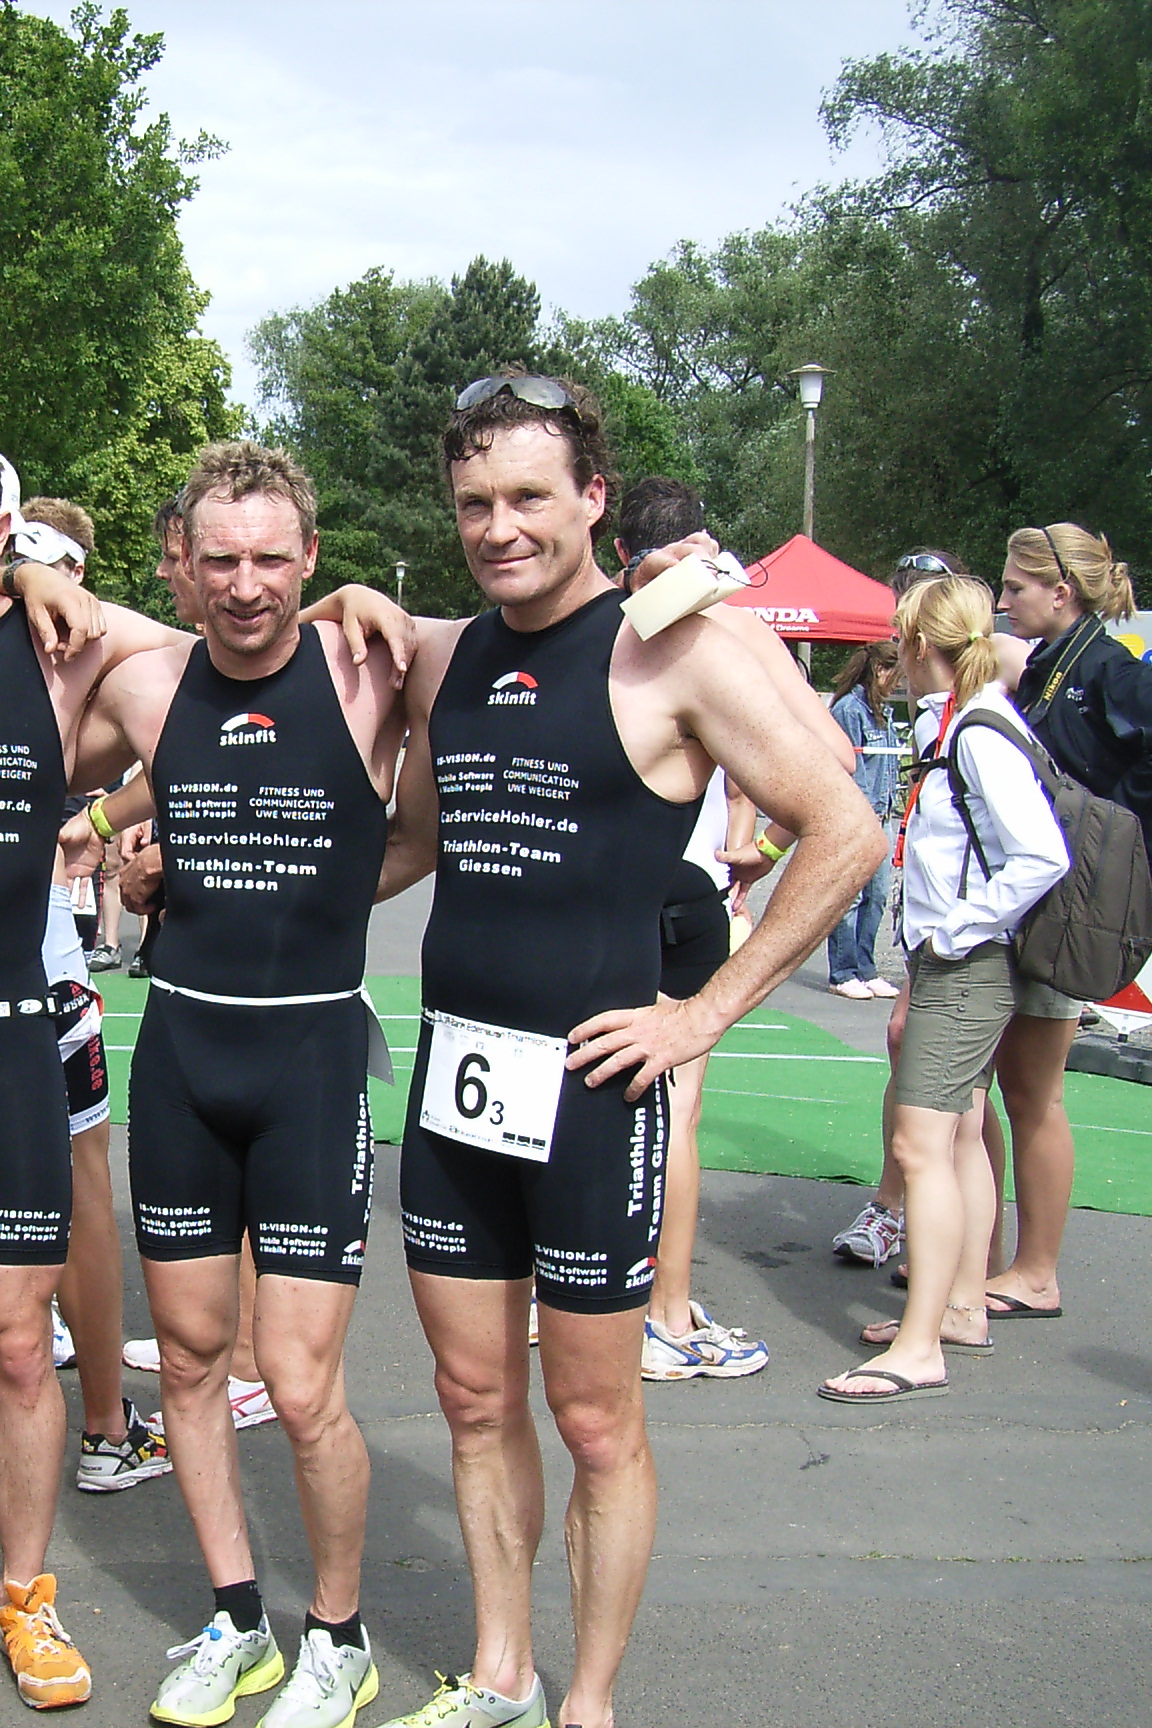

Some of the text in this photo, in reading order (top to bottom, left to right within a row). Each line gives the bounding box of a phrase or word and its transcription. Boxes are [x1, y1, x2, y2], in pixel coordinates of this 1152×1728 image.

[754, 608, 819, 622] NDA
[1043, 672, 1062, 700] Nikon
[488, 692, 536, 705] skinfit
[220, 730, 276, 746] skinfit
[11, 746, 30, 754] UND
[512, 757, 569, 773] FITNESS UND
[459, 772, 494, 781] Software
[503, 770, 579, 789] COMMUNICATION
[259, 787, 324, 797] FITNESS UND
[465, 783, 493, 792] People
[508, 784, 571, 800] UWE WEIGERT
[196, 800, 236, 808] Software
[249, 798, 334, 809] COMMUNICATION
[203, 810, 236, 819] People
[256, 810, 326, 820] UWE WEIGERT
[441, 809, 578, 833] CarServiceHohler.de
[170, 832, 332, 848] CarServiceHohler.de
[443, 840, 561, 863] Triathlon-Team
[177, 859, 317, 875] Triathlon-Team
[459, 859, 522, 877] Giessen
[203, 876, 278, 891] Giessen
[455, 1053, 490, 1119] 6
[490, 1101, 504, 1125] 3
[352, 1093, 366, 1194] Triathlon
[627, 1107, 646, 1217] Triathlon
[648, 1174, 662, 1242] Team
[14, 1224, 58, 1232] Software
[180, 1227, 212, 1236] People
[23, 1233, 56, 1242] People
[420, 1231, 465, 1244] Software
[290, 1247, 325, 1257] People
[429, 1241, 466, 1253] People
[559, 1265, 607, 1275] Software
[540, 1269, 607, 1286] Mobile People
